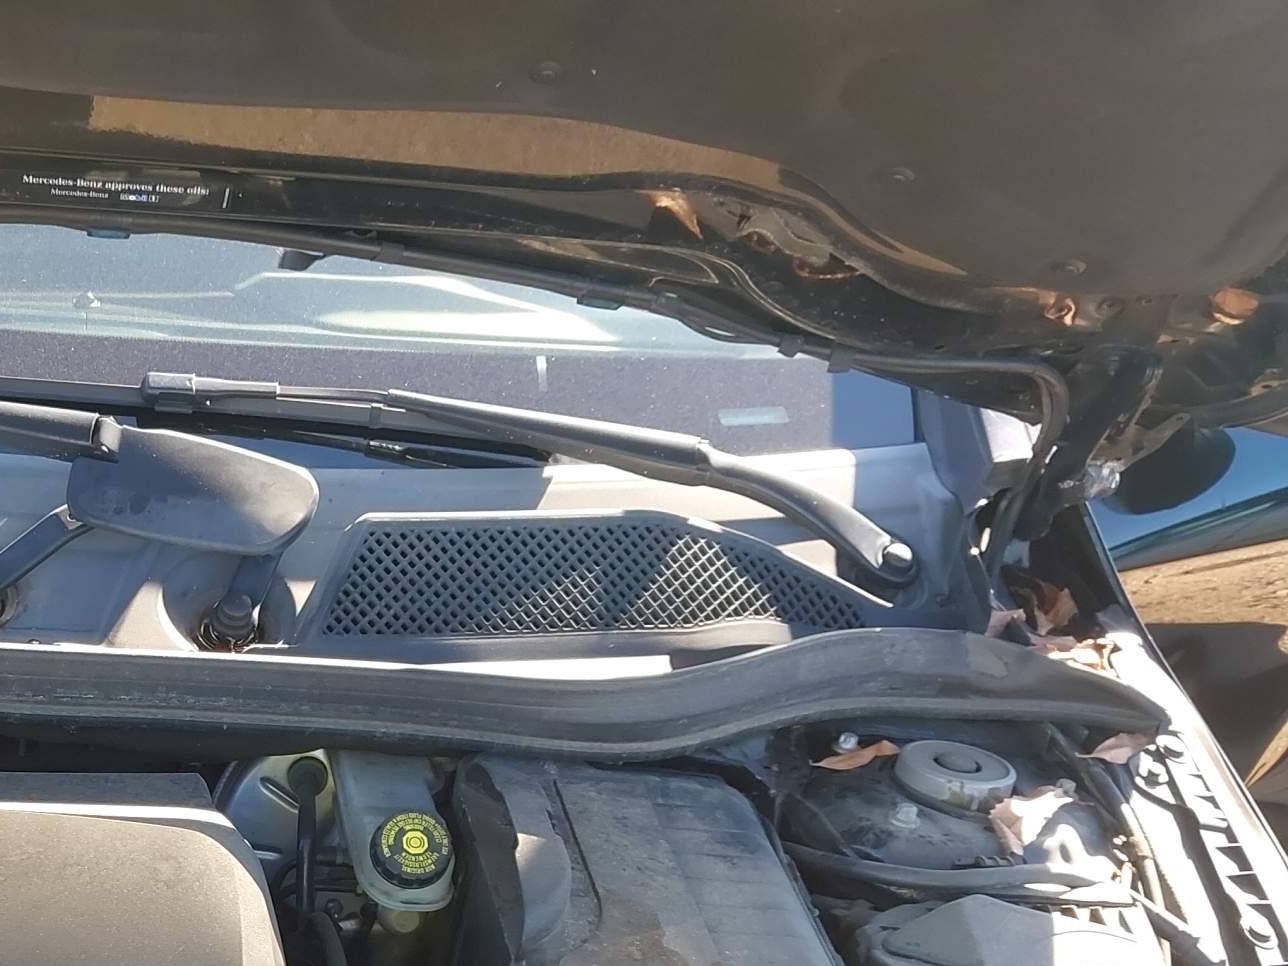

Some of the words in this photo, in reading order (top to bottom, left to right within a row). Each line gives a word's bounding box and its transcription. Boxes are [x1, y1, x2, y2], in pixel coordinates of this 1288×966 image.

[22, 174, 104, 189] Mercedes-Benz
[105, 181, 153, 193] approves
[156, 184, 185, 195] these
[186, 186, 210, 197] oils:
[50, 188, 109, 199] Mercedes-Benz
